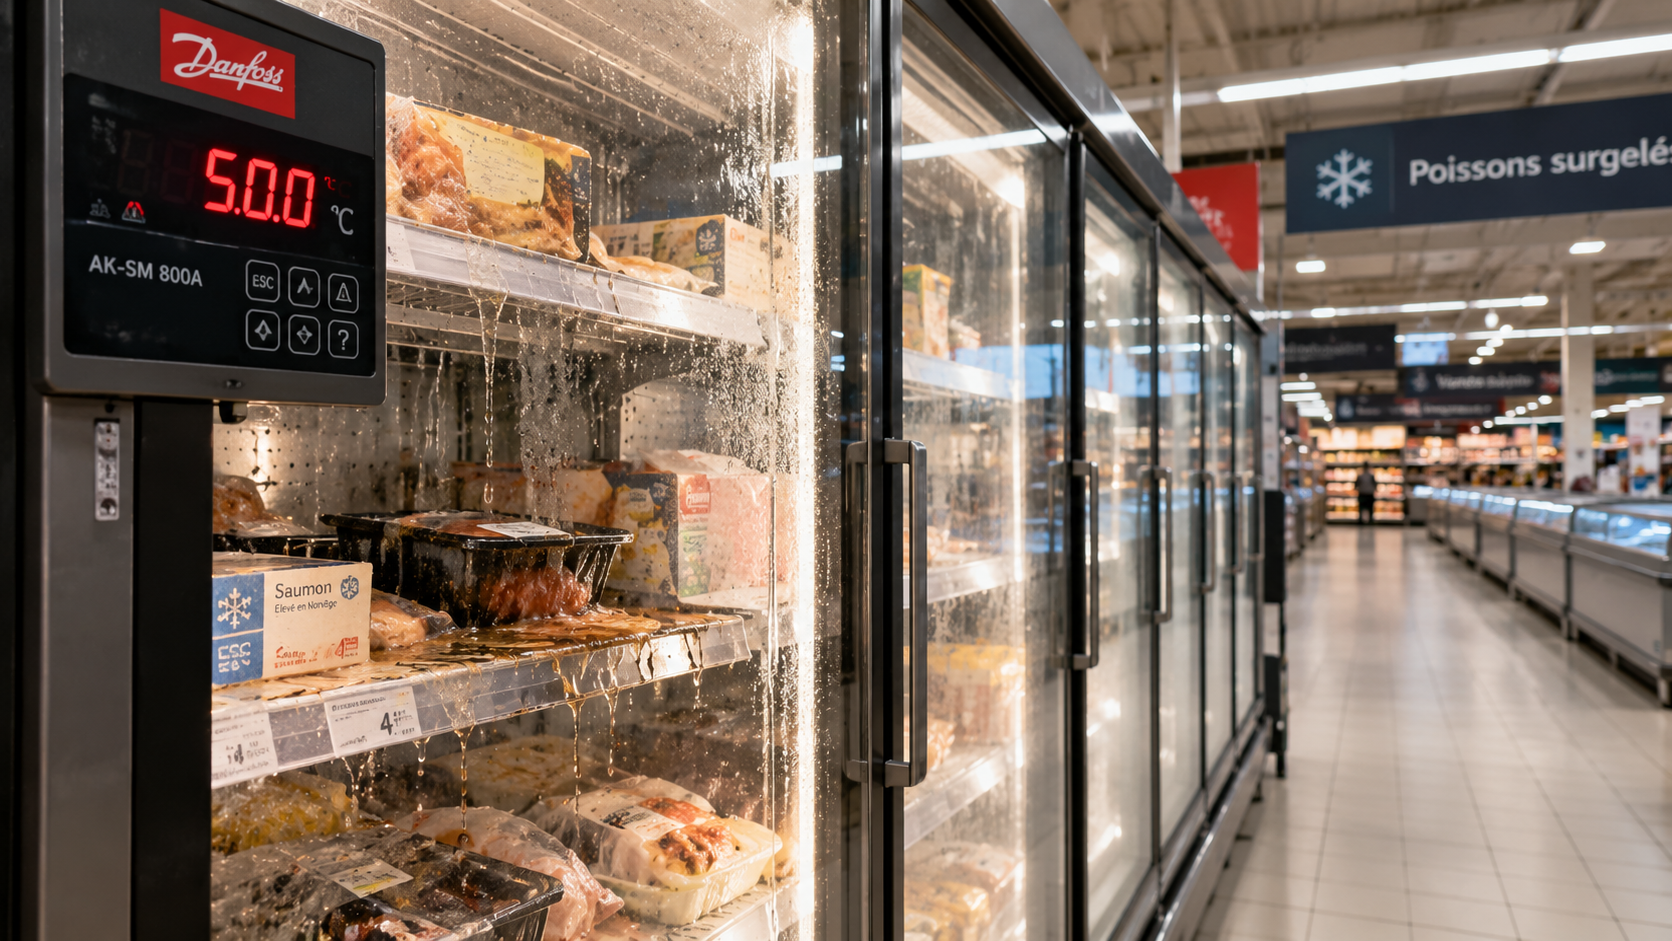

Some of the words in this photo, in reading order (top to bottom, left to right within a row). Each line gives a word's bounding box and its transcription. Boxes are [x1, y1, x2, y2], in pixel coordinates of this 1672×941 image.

[172, 32, 284, 92] Danfoss
[1409, 155, 1542, 186] Poissons
[1550, 136, 1672, 177] surgelé
[88, 254, 153, 280] AK-SM
[159, 264, 203, 287] 800A
[252, 274, 274, 290] ESC
[275, 583, 332, 599] Saumon
